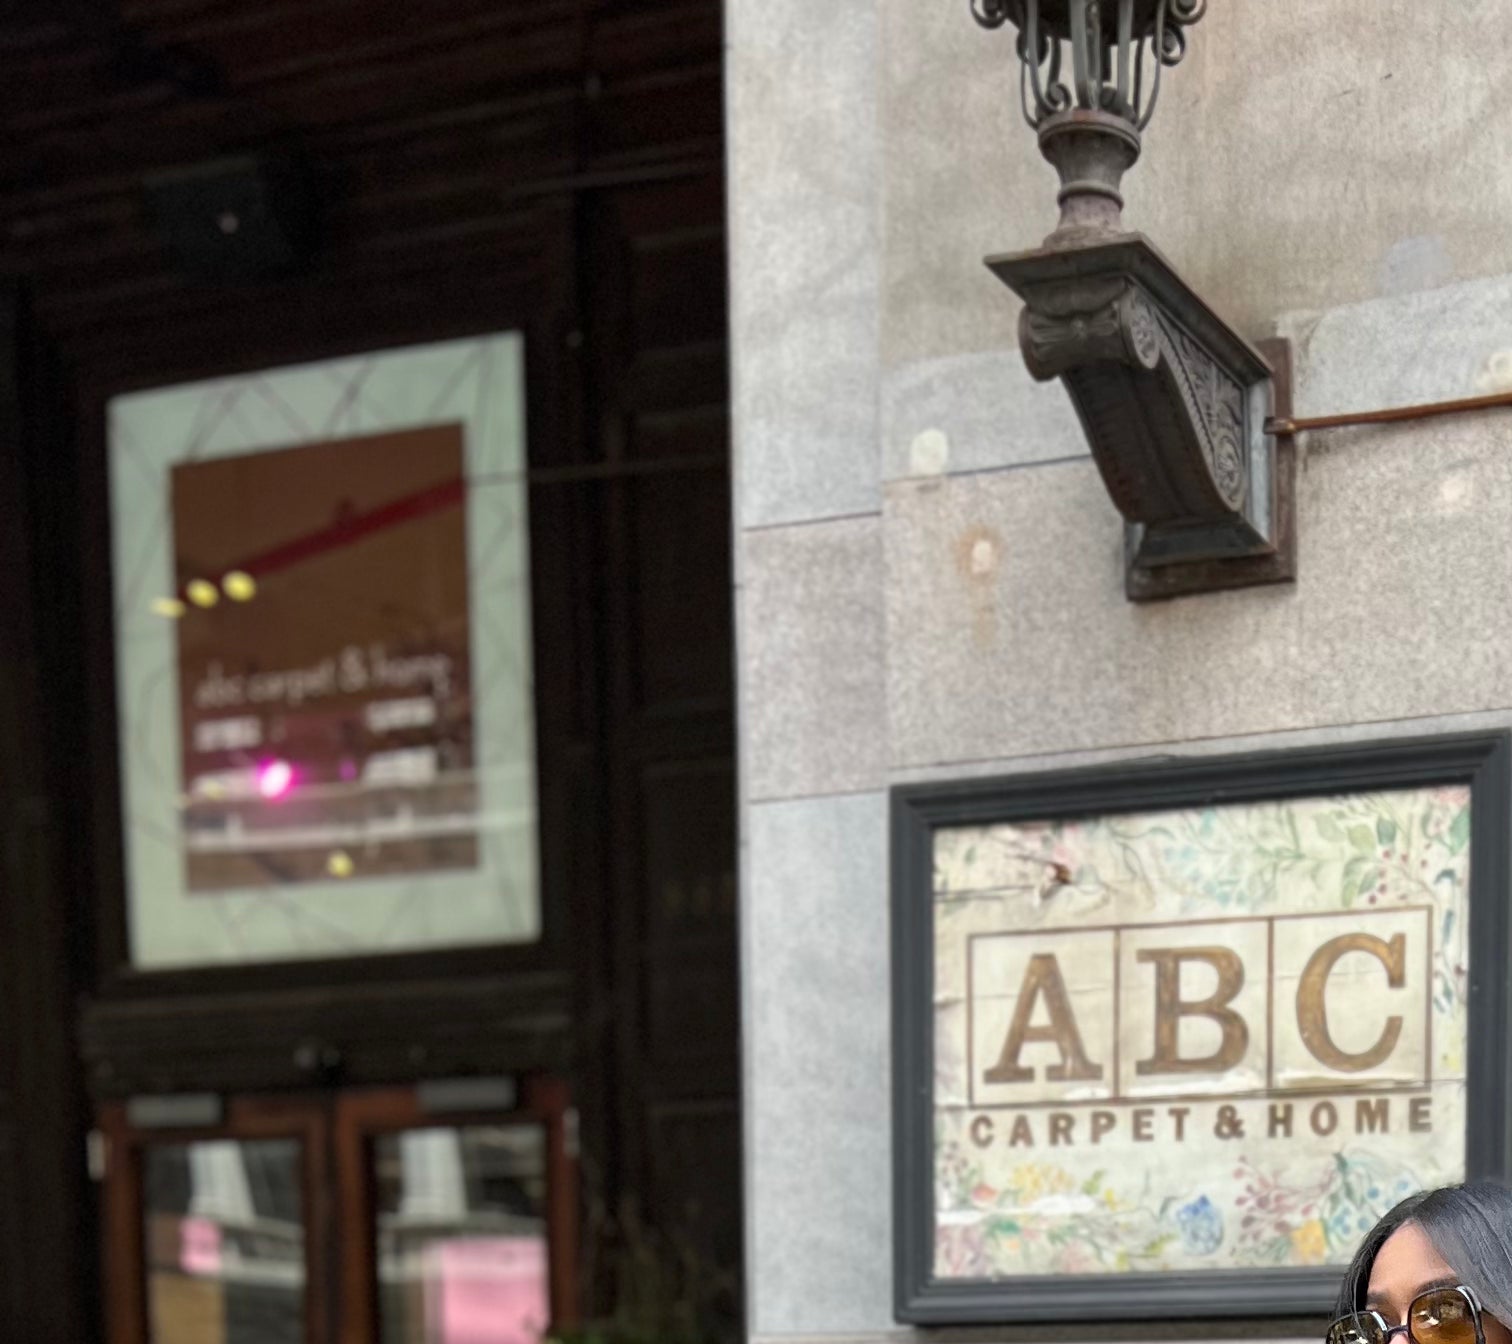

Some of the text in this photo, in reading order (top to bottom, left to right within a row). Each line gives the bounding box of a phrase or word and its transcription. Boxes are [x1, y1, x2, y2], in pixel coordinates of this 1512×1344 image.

[983, 932, 1406, 1084] ABC
[969, 1097, 1432, 1148] CARPET & HOME
